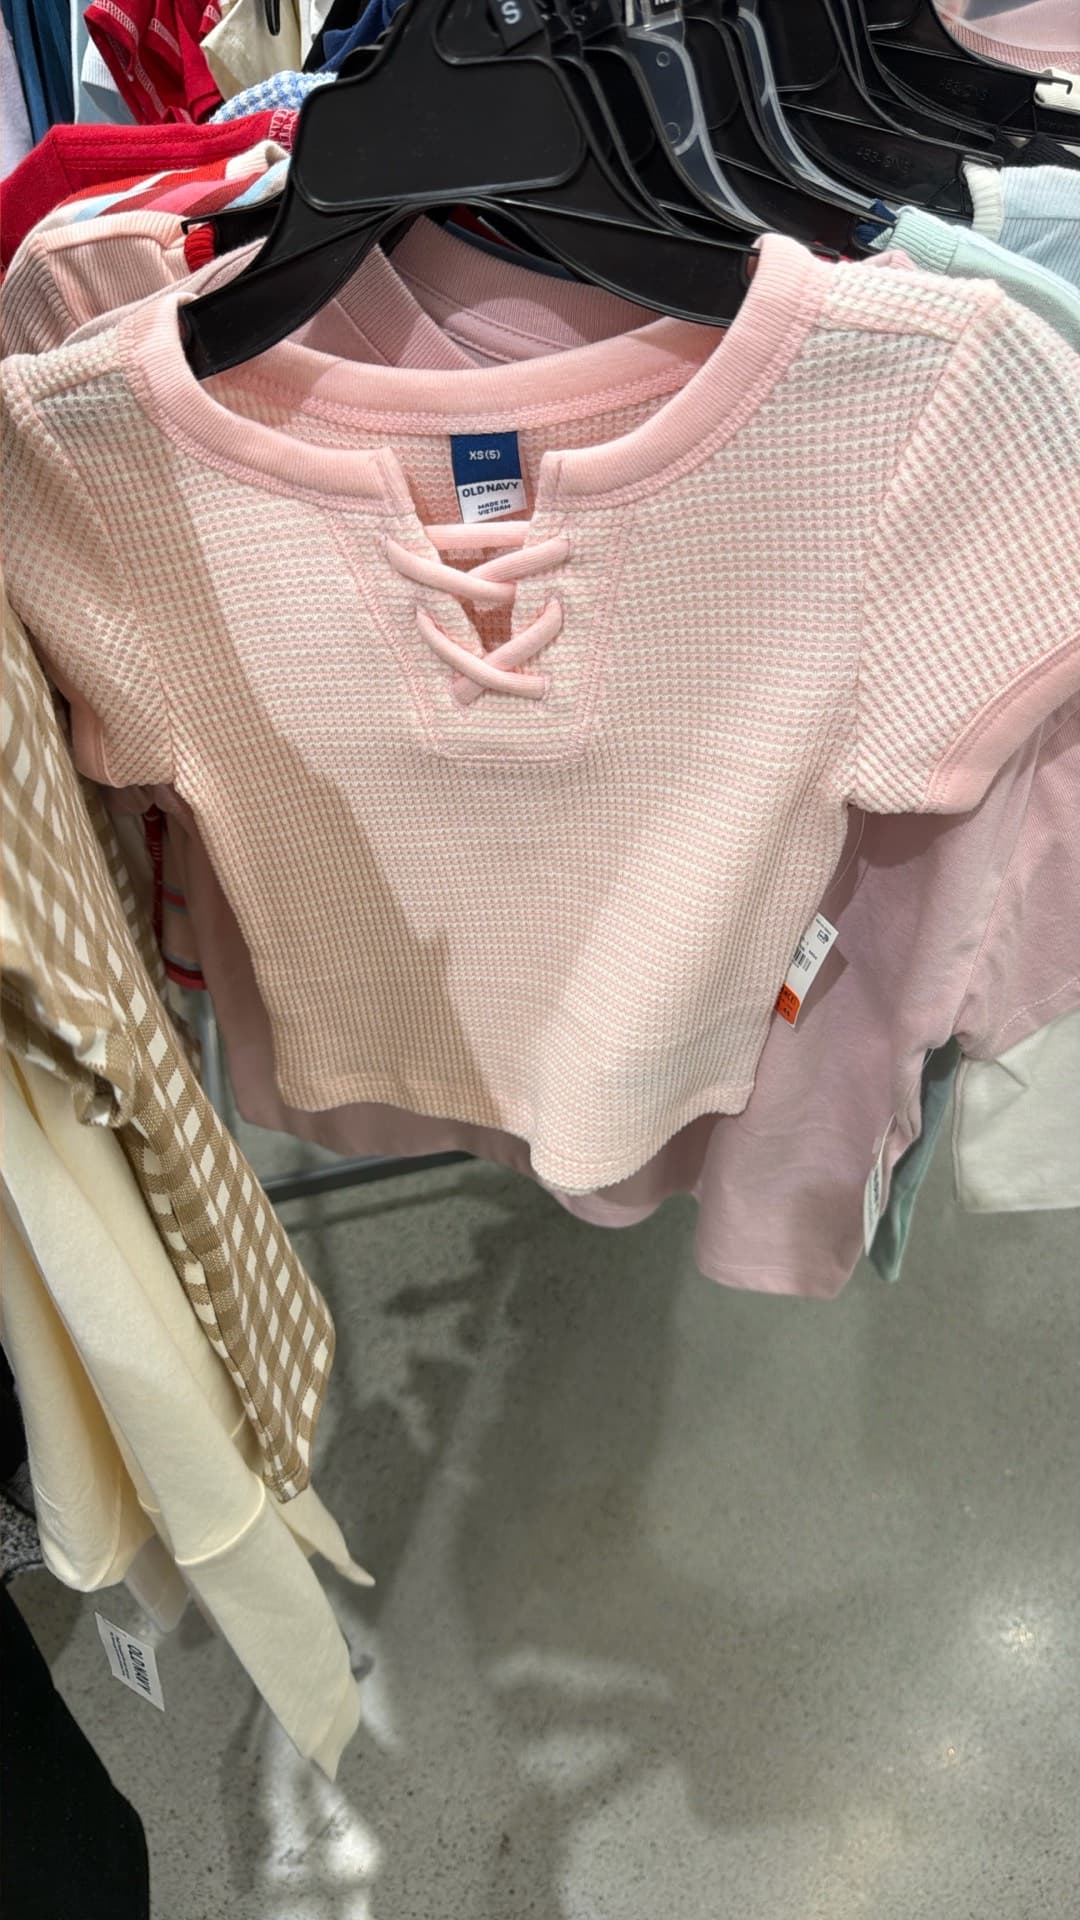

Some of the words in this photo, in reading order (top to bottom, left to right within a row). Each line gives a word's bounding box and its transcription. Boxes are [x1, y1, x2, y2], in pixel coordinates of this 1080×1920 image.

[469, 450, 501, 460] XS(5)
[462, 486, 485, 497] OLD
[486, 482, 518, 492] NAVY
[478, 501, 499, 509] MADE
[478, 504, 511, 515] VIETNAM
